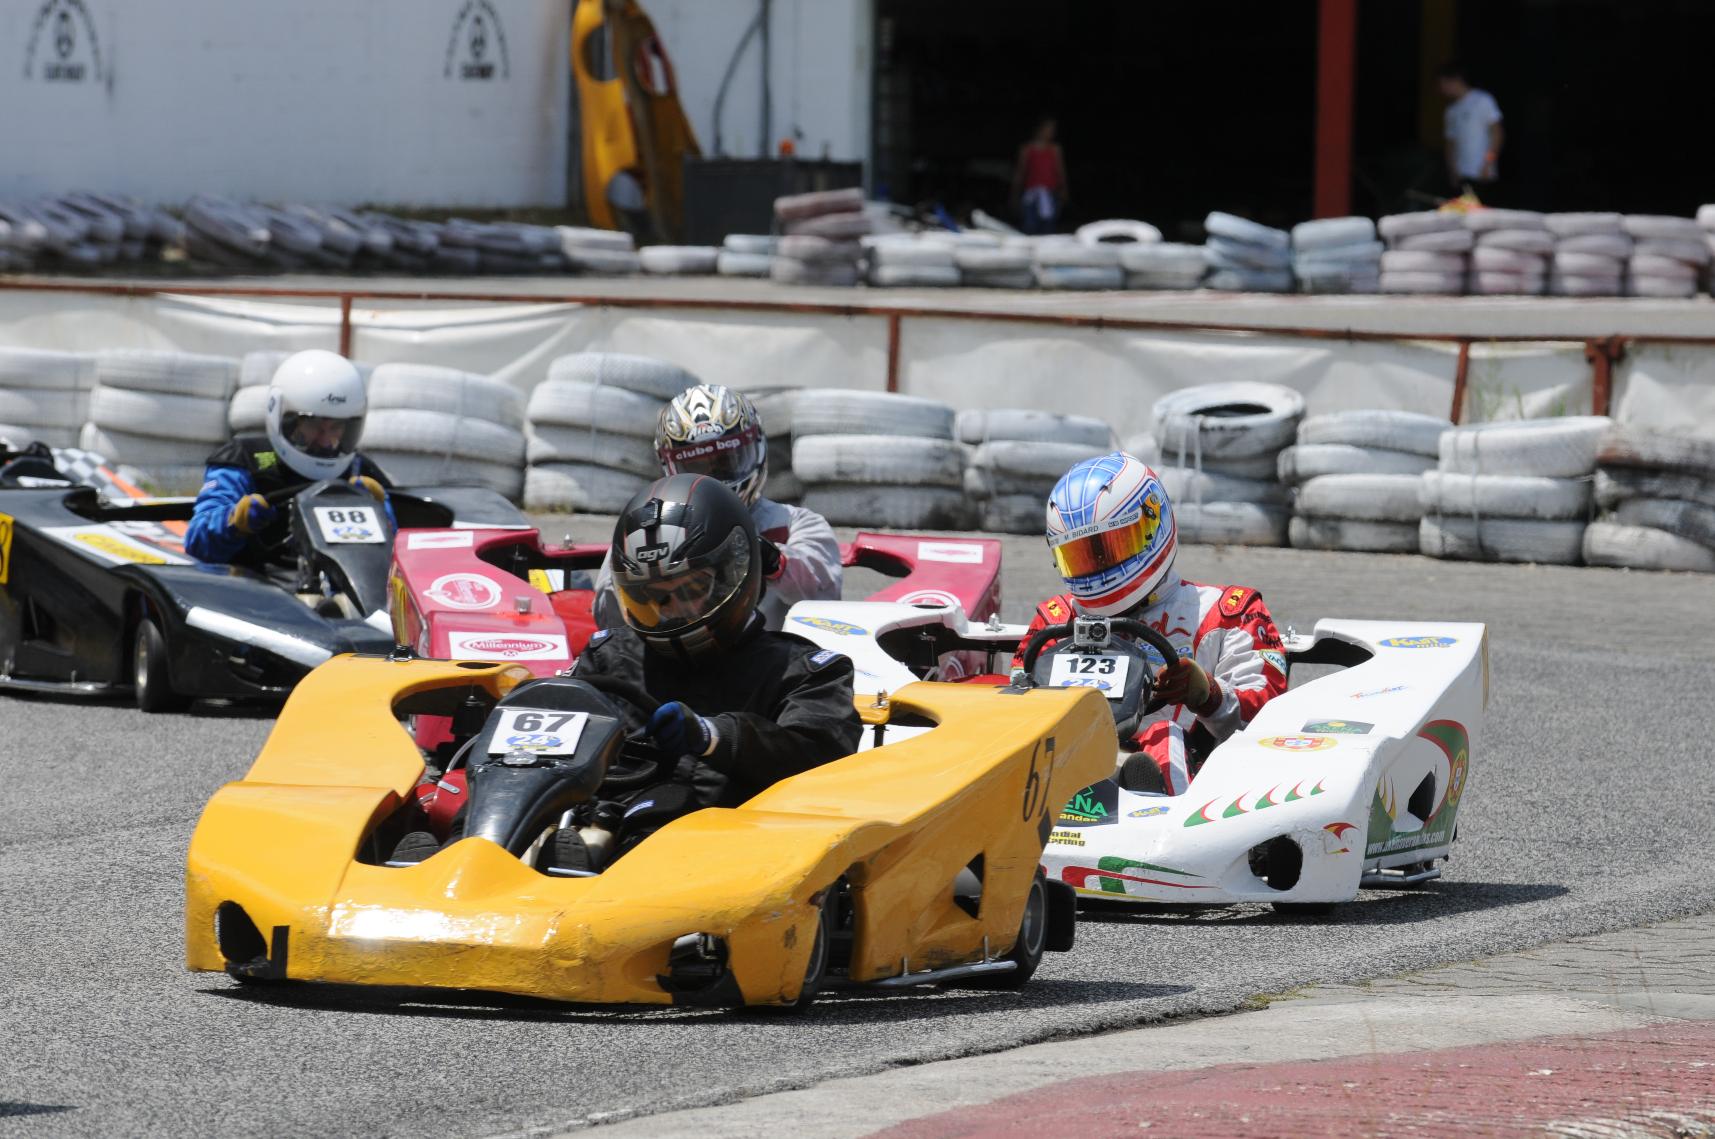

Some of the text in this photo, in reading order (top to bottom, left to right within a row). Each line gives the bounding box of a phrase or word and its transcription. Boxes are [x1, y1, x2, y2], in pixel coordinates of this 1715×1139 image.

[675, 438, 741, 460] clube bcp
[328, 510, 367, 524] 88
[1072, 525, 1099, 537] BIDARD
[638, 547, 668, 561] agv
[471, 640, 543, 650] Millennium
[1066, 657, 1116, 675] 123
[513, 713, 576, 732] 67
[1023, 736, 1056, 822] 67
